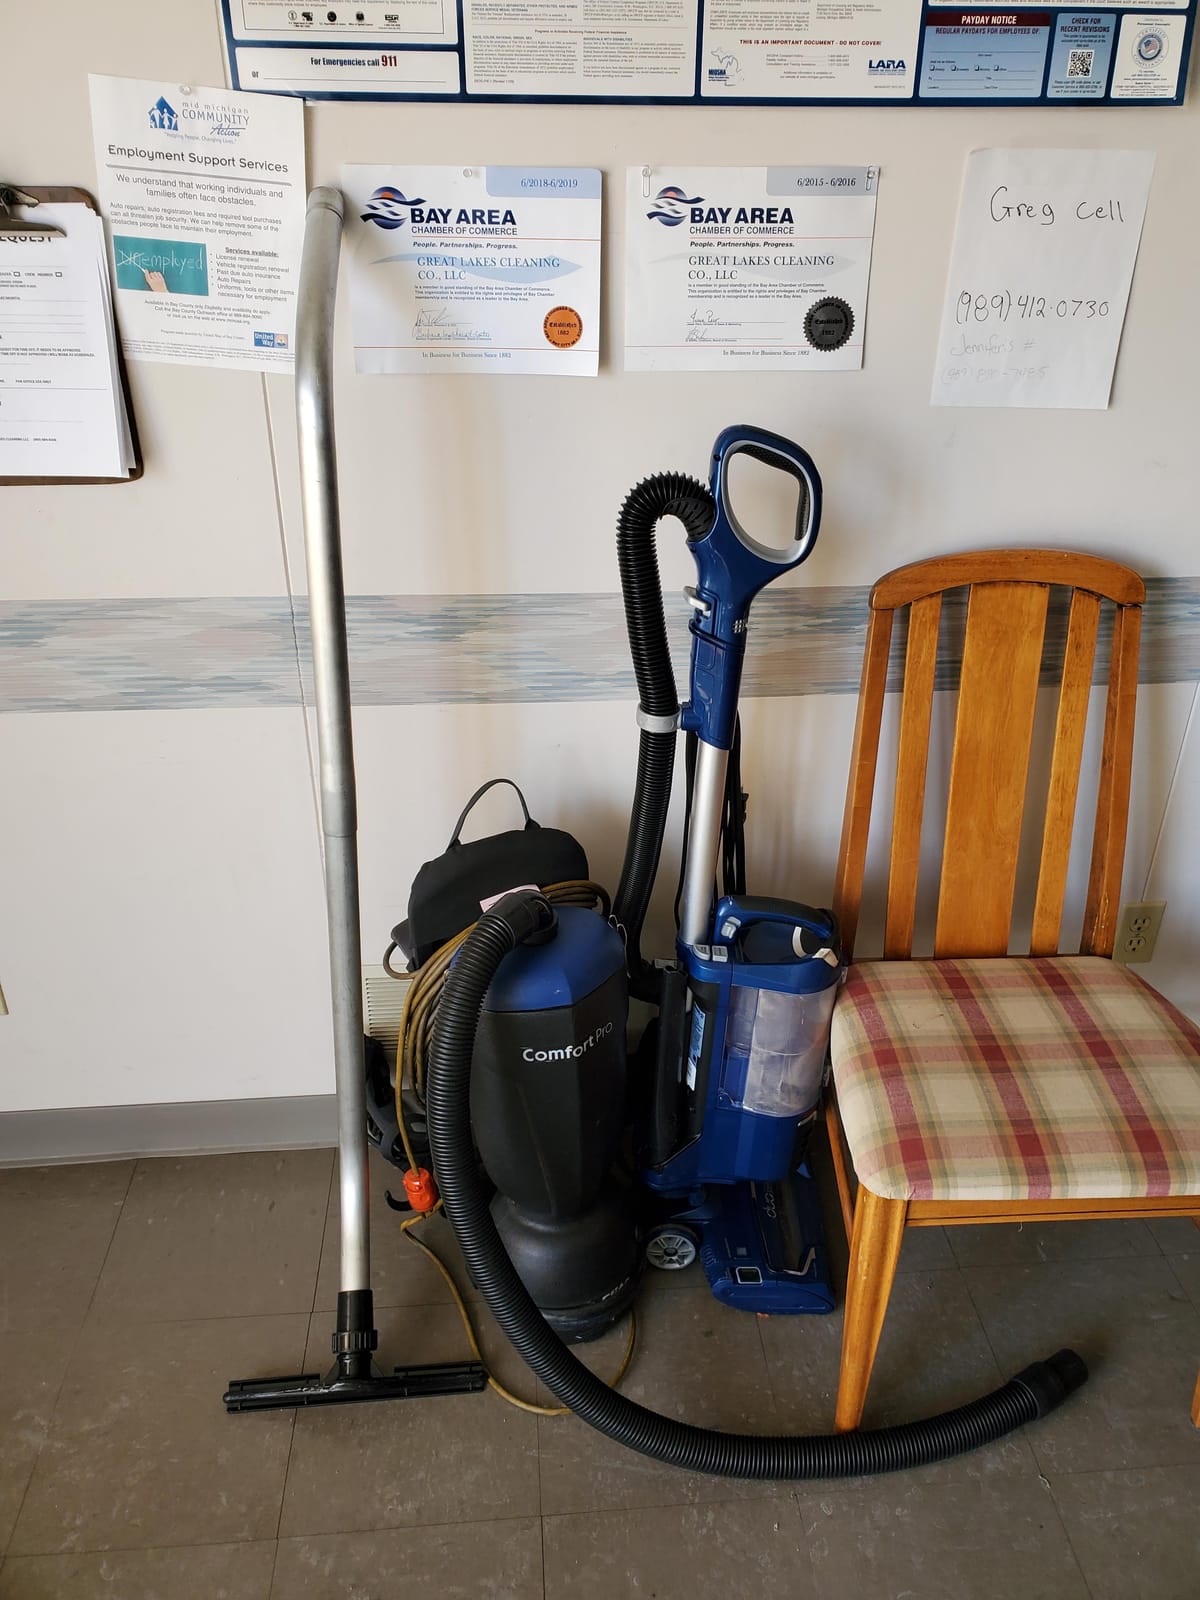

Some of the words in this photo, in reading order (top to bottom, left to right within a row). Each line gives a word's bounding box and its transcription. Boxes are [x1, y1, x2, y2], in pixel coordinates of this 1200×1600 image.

[961, 16, 990, 24] PAYDAY
[991, 16, 1017, 24] NOTICE
[310, 57, 321, 66] For
[322, 57, 366, 67] Emergencies
[367, 58, 380, 66] call
[381, 55, 398, 67] 911
[868, 60, 906, 69] LARA
[204, 104, 248, 114] michigan
[182, 109, 249, 125] COMMUNITY
[210, 123, 246, 136] Action
[108, 144, 185, 161] Employment
[188, 152, 235, 167] Support
[239, 158, 288, 173] Services
[116, 174, 130, 182] We
[132, 176, 176, 187] understand
[178, 180, 194, 189] that
[196, 183, 225, 193] working
[227, 184, 267, 197] individuals
[269, 190, 283, 198] and
[520, 178, 578, 188] 6/2018-6/2019
[797, 178, 824, 187] 6/2015
[830, 178, 856, 187] 6/2016
[146, 188, 176, 198] families
[178, 191, 198, 200] often
[200, 193, 216, 202] face
[218, 196, 256, 206] obstacles.
[990, 186, 1054, 225] Greg
[410, 208, 452, 225] BAY
[456, 209, 516, 225] AREA
[690, 208, 732, 224] BAY
[735, 208, 794, 224] AREA
[412, 226, 454, 234] CHAMBER
[456, 226, 467, 234] OF
[469, 227, 518, 236] COMMERCE
[412, 241, 437, 249] People.
[417, 256, 458, 266] GREAT
[460, 257, 497, 267] LAKES
[500, 257, 560, 268] CLEANING
[689, 256, 730, 266] GREAT
[732, 256, 770, 266] LAKES
[773, 256, 834, 266] CLEANING
[418, 270, 442, 281] CO.,
[444, 271, 466, 280] LLC
[688, 270, 712, 281] CO.,
[715, 270, 737, 280] LLC
[254, 332, 273, 340] United
[261, 339, 274, 347] Way
[522, 1034, 594, 1062] Comfort
[596, 1022, 613, 1043] Pro
